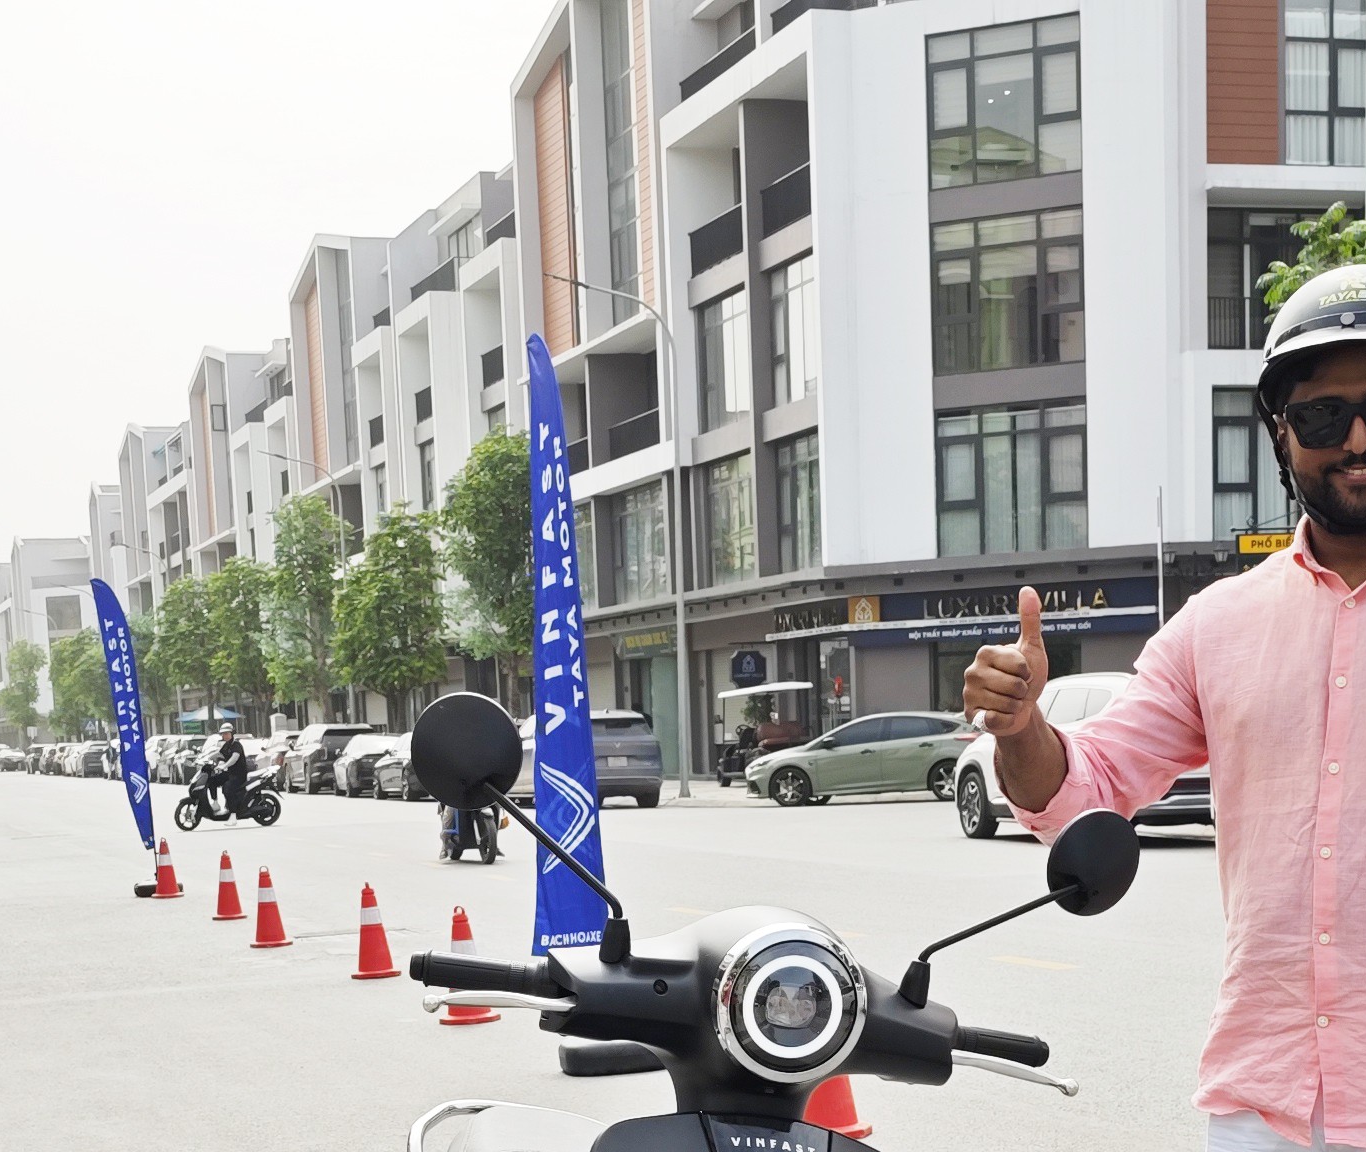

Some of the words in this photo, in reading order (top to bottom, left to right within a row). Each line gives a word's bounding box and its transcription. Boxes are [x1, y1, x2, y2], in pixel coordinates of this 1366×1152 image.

[1319, 291, 1357, 306] TAYA
[553, 436, 574, 588] MOTOR
[1251, 536, 1272, 548] PHỐ
[539, 423, 566, 735] VINFAST
[117, 627, 133, 692] MOTOR
[566, 604, 584, 707] TAYA
[129, 699, 141, 743] TAYA
